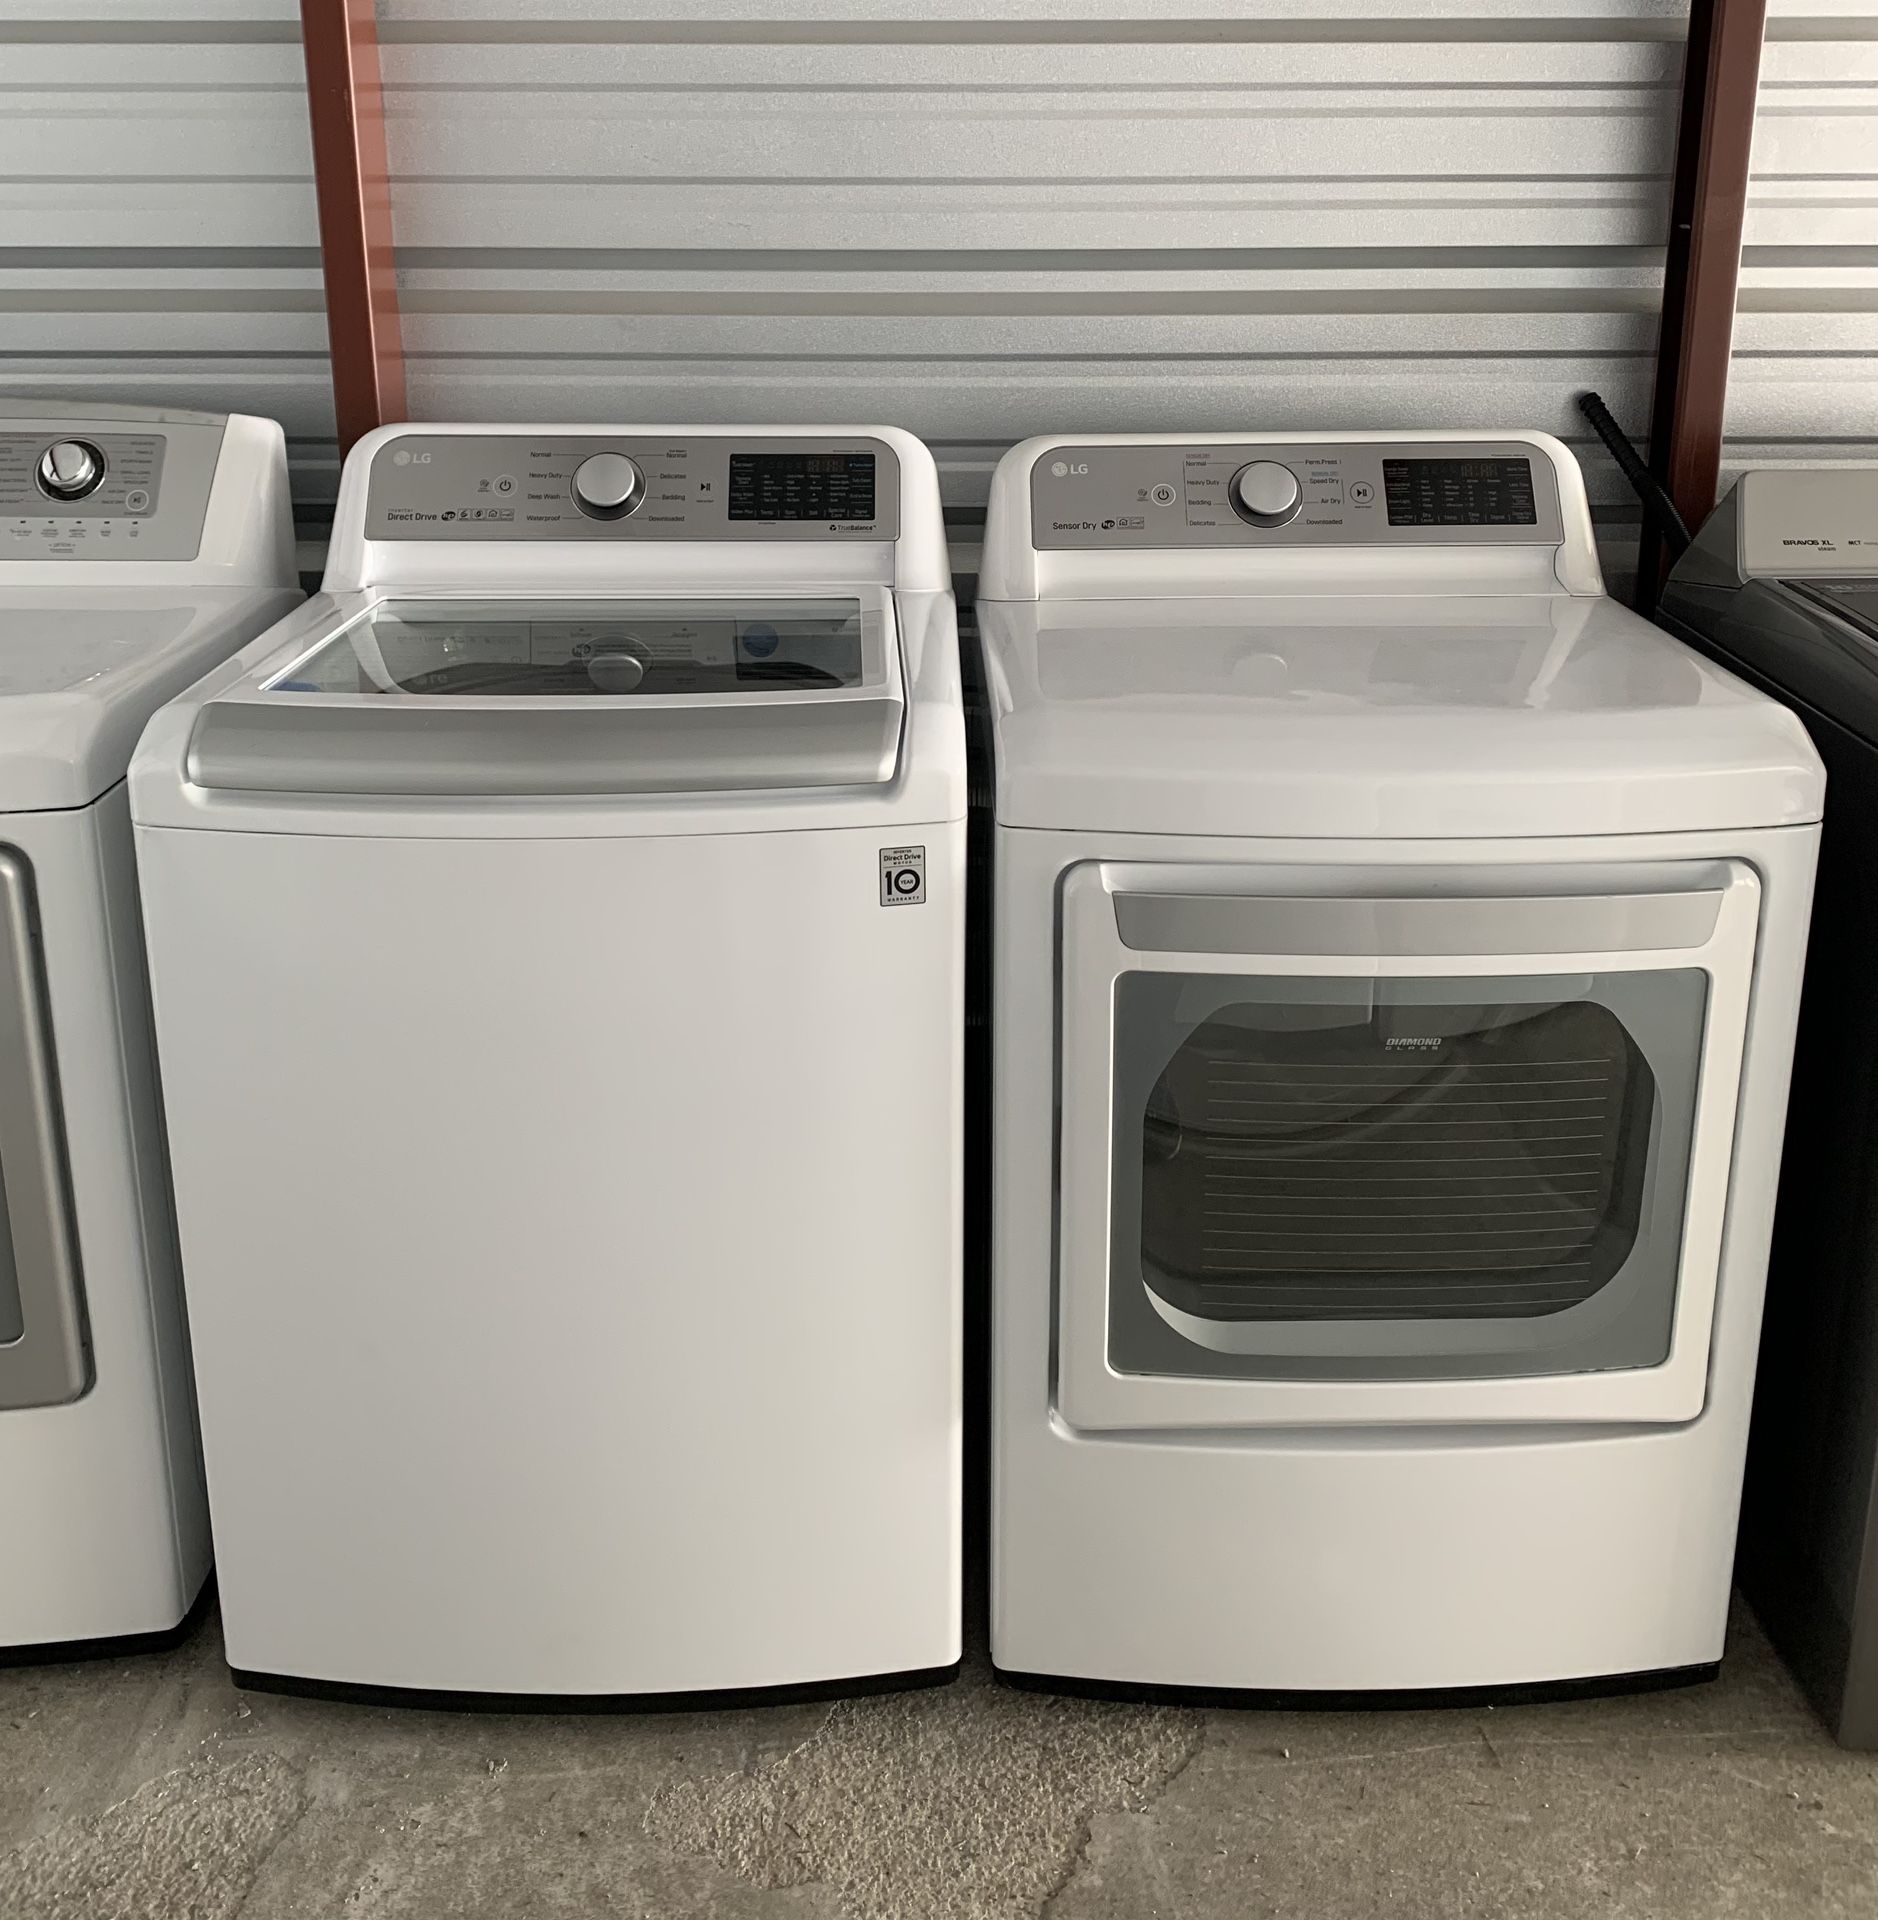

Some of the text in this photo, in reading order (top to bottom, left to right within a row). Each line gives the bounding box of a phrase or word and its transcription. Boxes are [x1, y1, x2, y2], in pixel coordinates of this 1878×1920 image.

[412, 453, 432, 464] LG
[1070, 463, 1089, 475] LG
[528, 472, 562, 480] Heavy Duty
[1328, 477, 1339, 485] Dry
[387, 512, 438, 521] Direct Drive
[1052, 521, 1097, 531] Sensor Dry
[885, 869, 920, 896] 10
